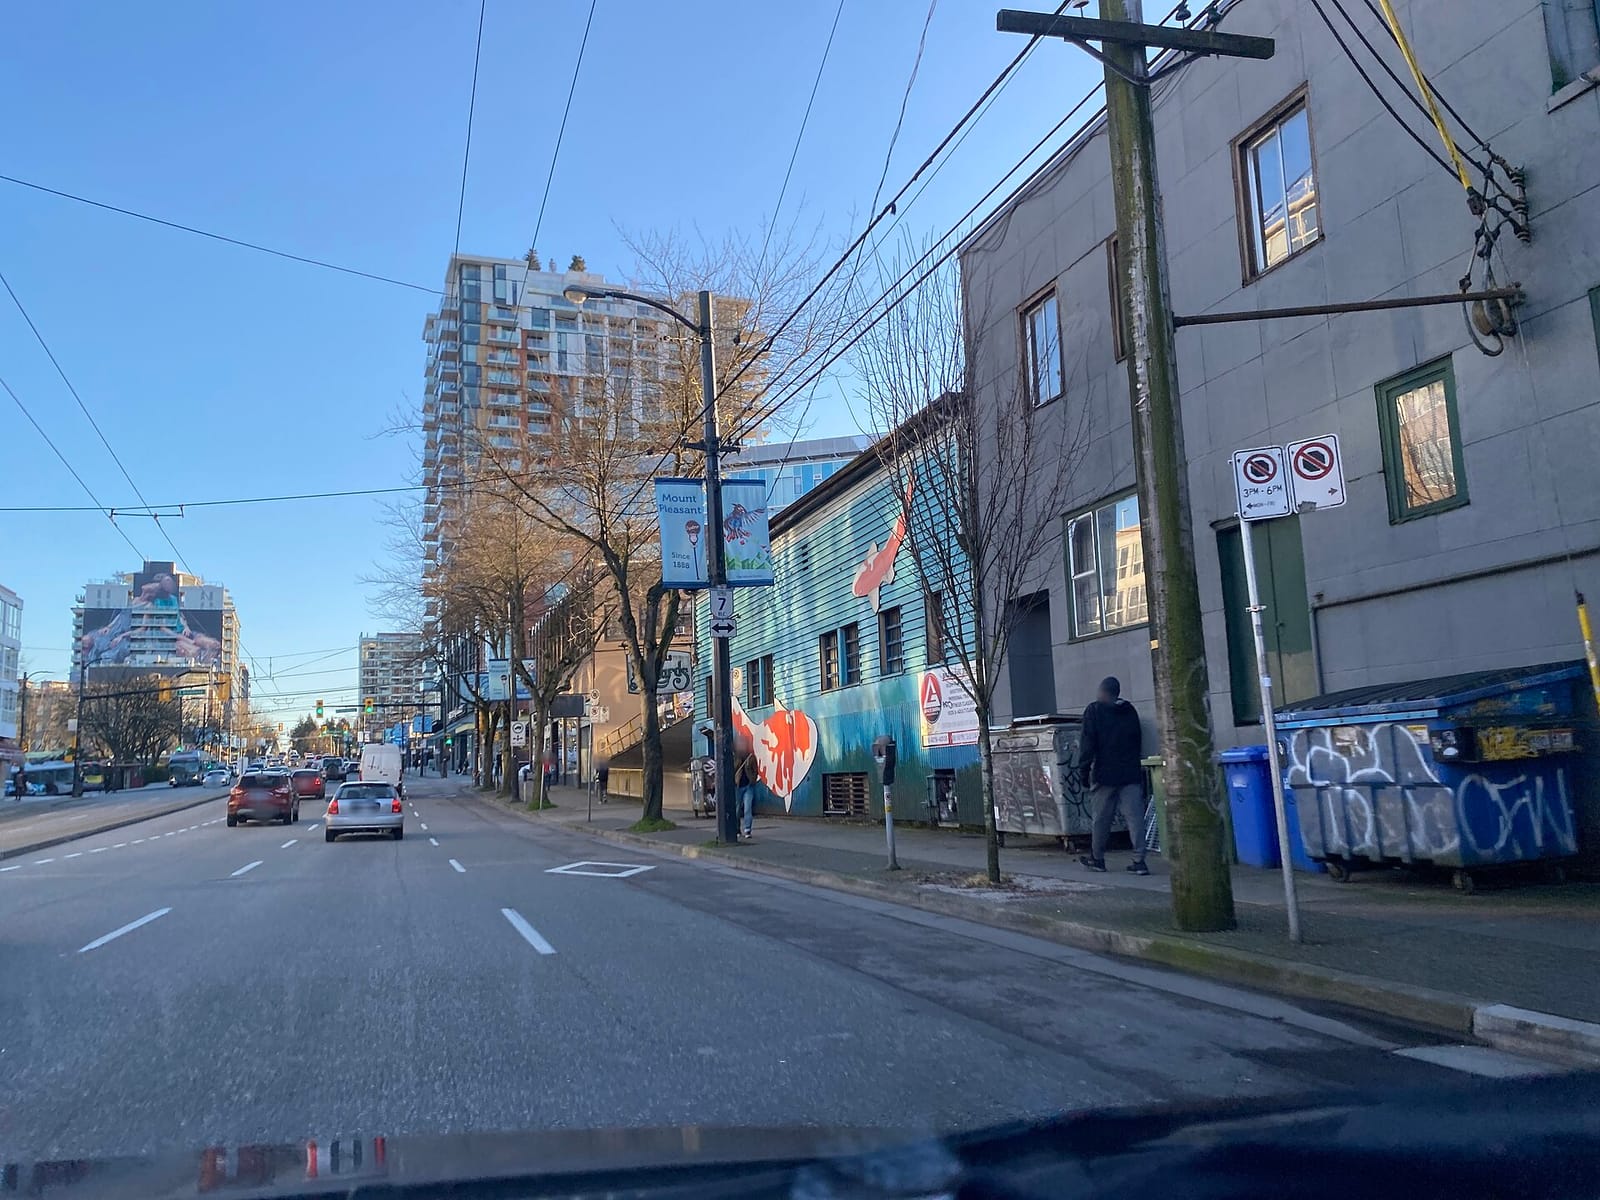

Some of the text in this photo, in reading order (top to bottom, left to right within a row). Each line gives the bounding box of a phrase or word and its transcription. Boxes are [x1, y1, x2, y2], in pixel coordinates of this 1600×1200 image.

[1266, 484, 1282, 495] 6PM
[662, 493, 697, 503] Mount
[658, 504, 702, 514] Pleasant
[671, 551, 691, 560] Since
[717, 597, 726, 611] 7
